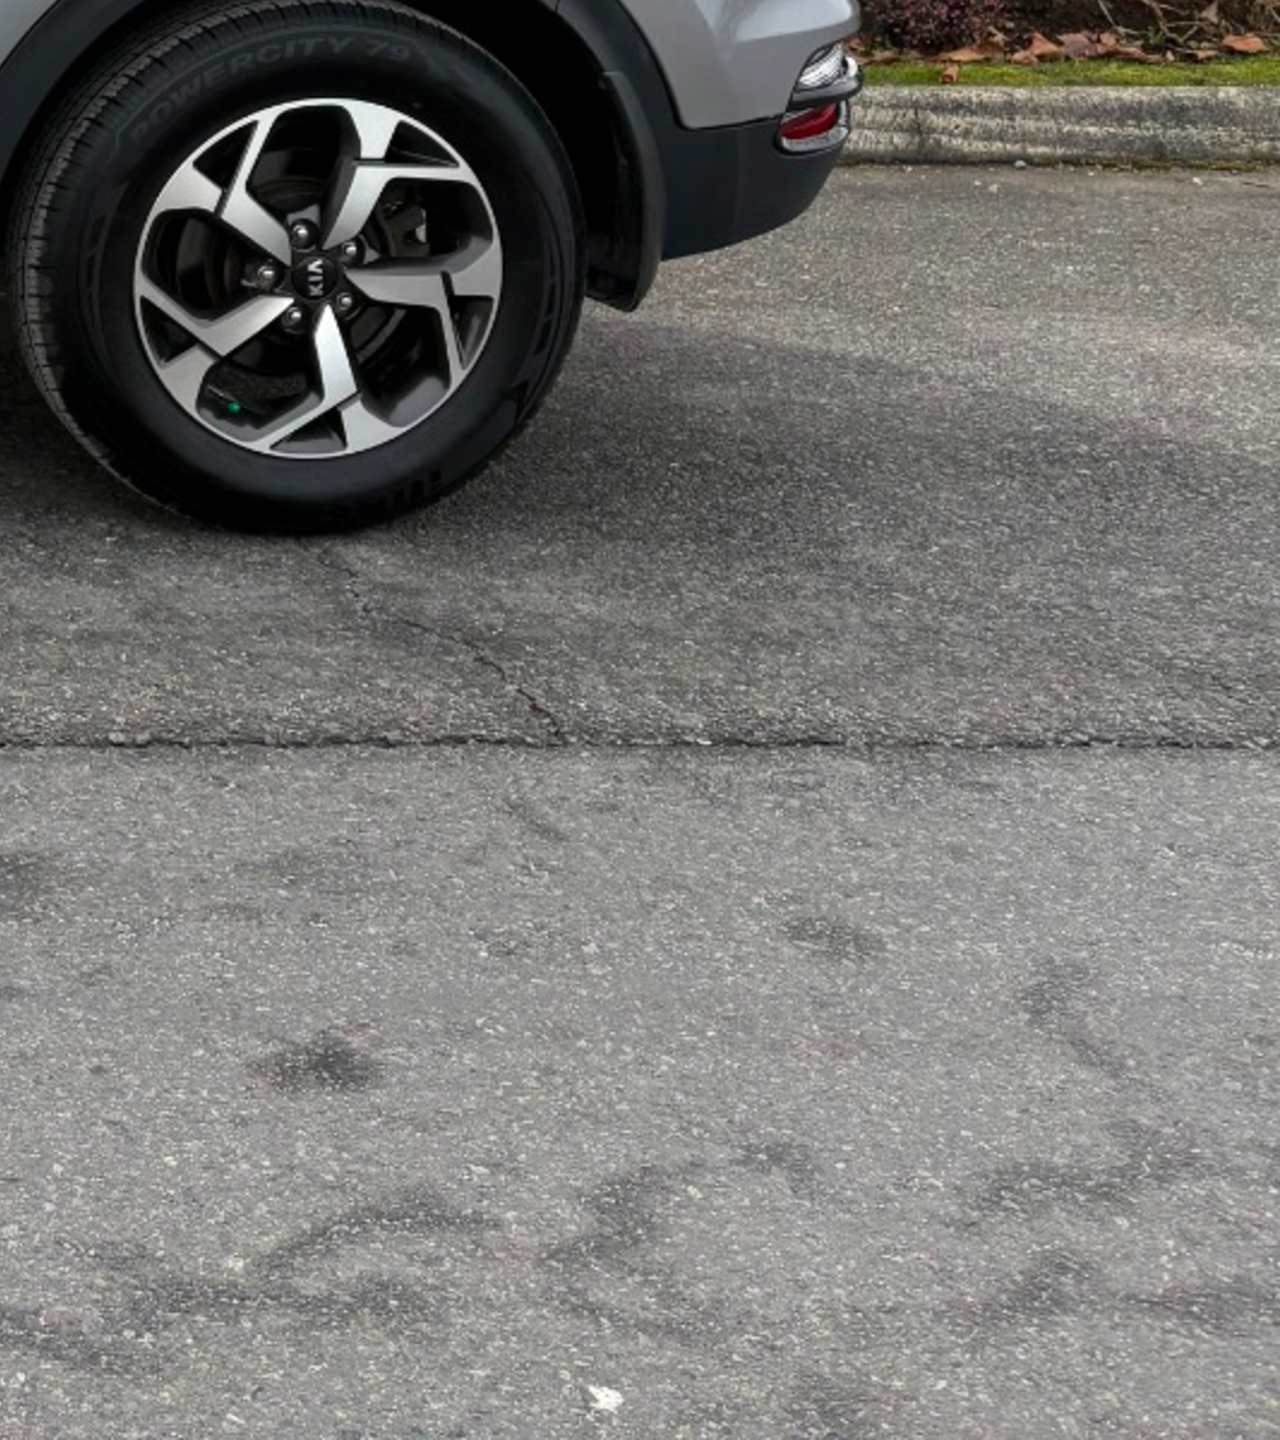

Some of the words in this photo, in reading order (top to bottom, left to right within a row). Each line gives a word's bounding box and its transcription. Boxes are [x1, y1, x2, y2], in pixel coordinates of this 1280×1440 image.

[131, 36, 351, 144] POWERCITY
[366, 39, 412, 61] 79
[307, 259, 323, 296] KIA
